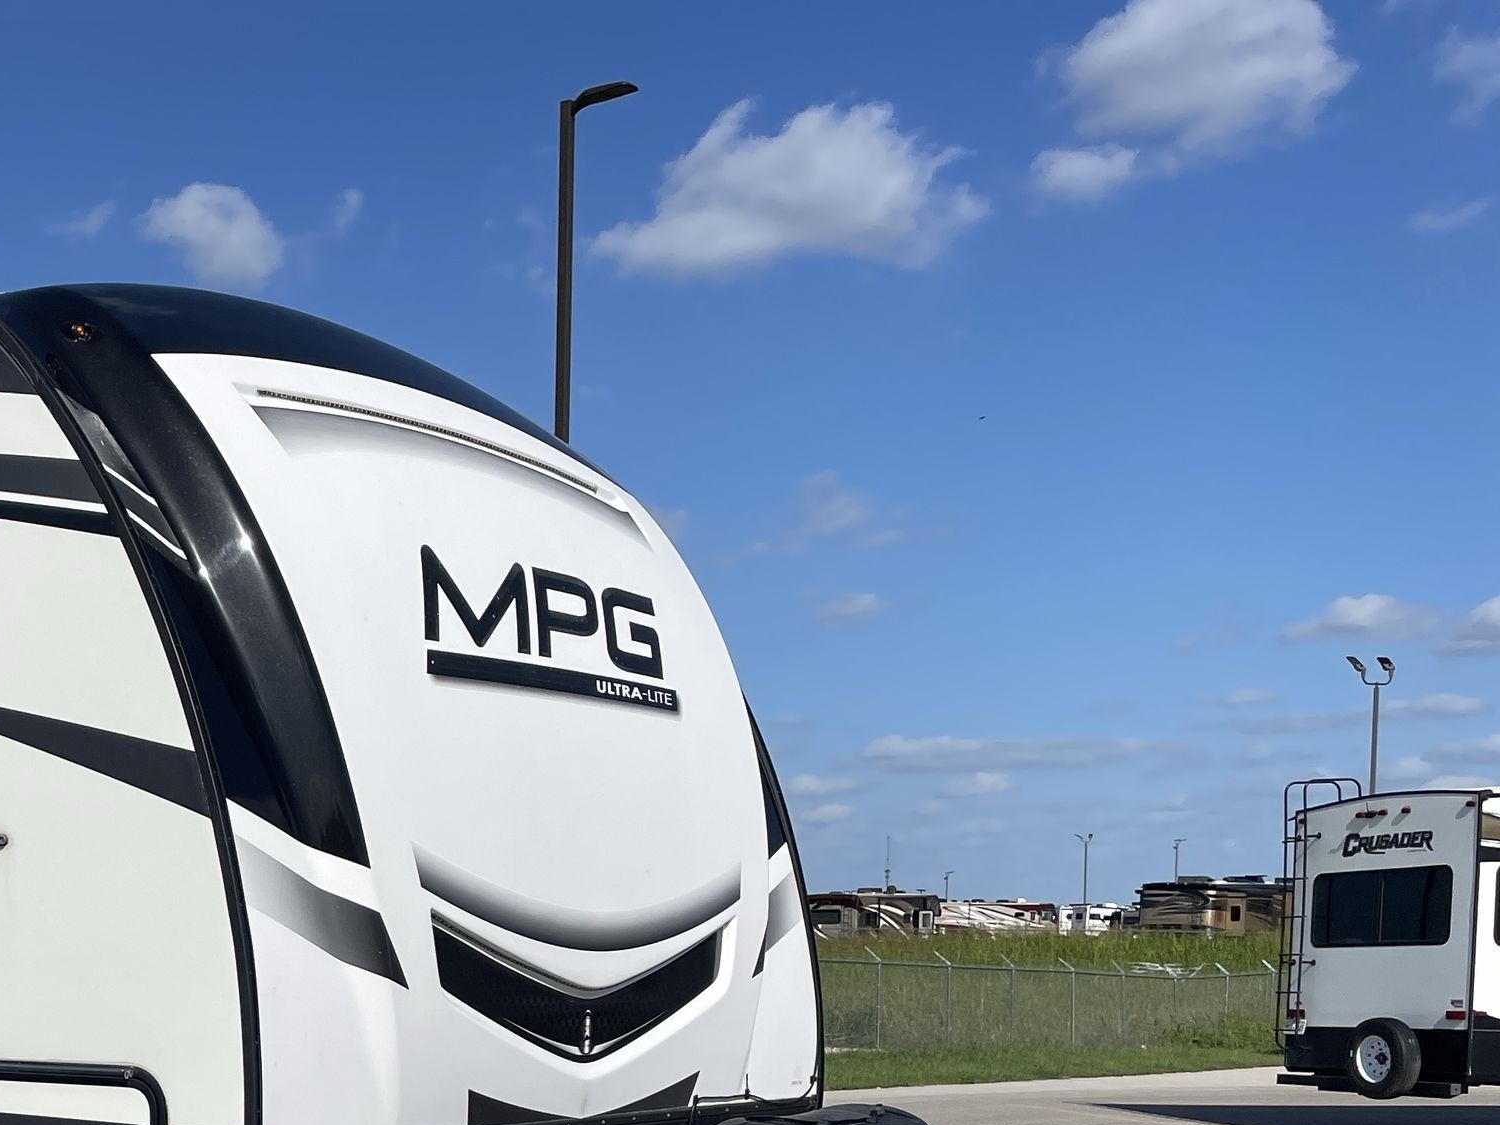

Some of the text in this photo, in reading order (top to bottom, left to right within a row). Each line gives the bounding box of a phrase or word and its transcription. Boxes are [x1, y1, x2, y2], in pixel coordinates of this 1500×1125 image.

[420, 544, 664, 680] MPG
[595, 679, 673, 706] ULTRA-LITE
[1342, 830, 1433, 857] CRUSADER
